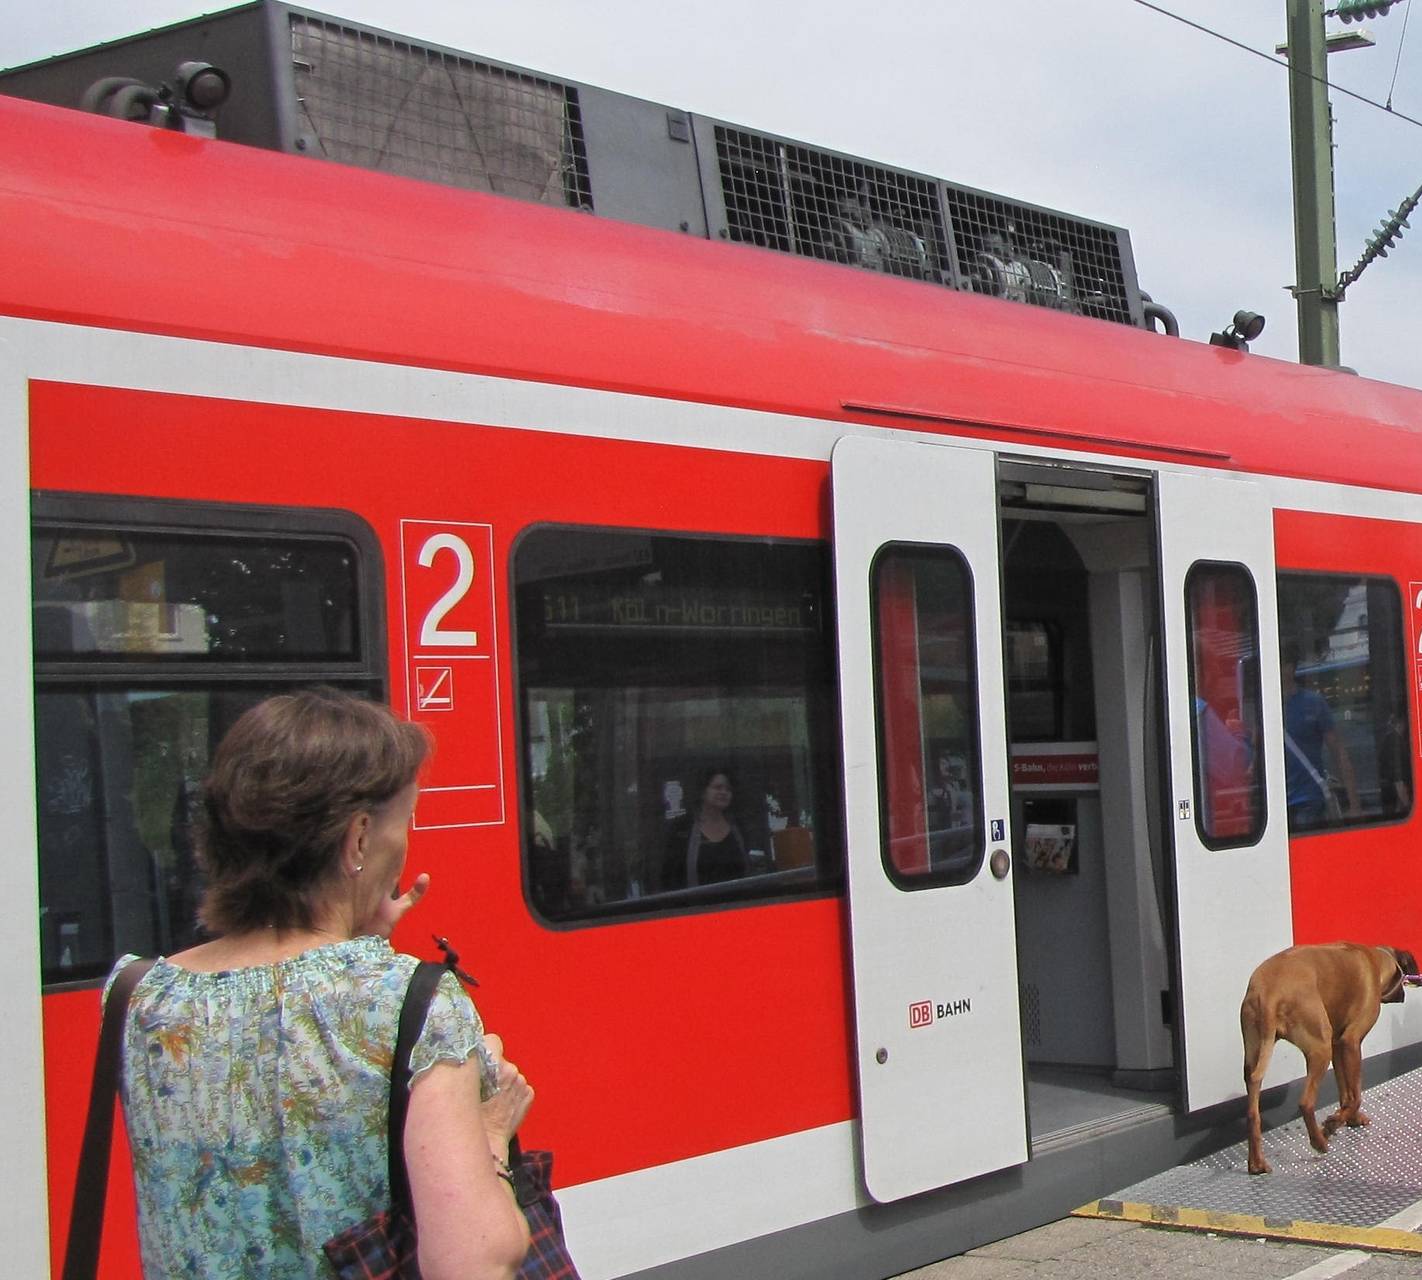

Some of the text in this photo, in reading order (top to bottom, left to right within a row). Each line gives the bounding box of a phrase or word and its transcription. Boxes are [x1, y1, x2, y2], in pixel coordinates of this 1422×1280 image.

[417, 533, 477, 646] 2
[910, 999, 971, 1026] DB BAHN
